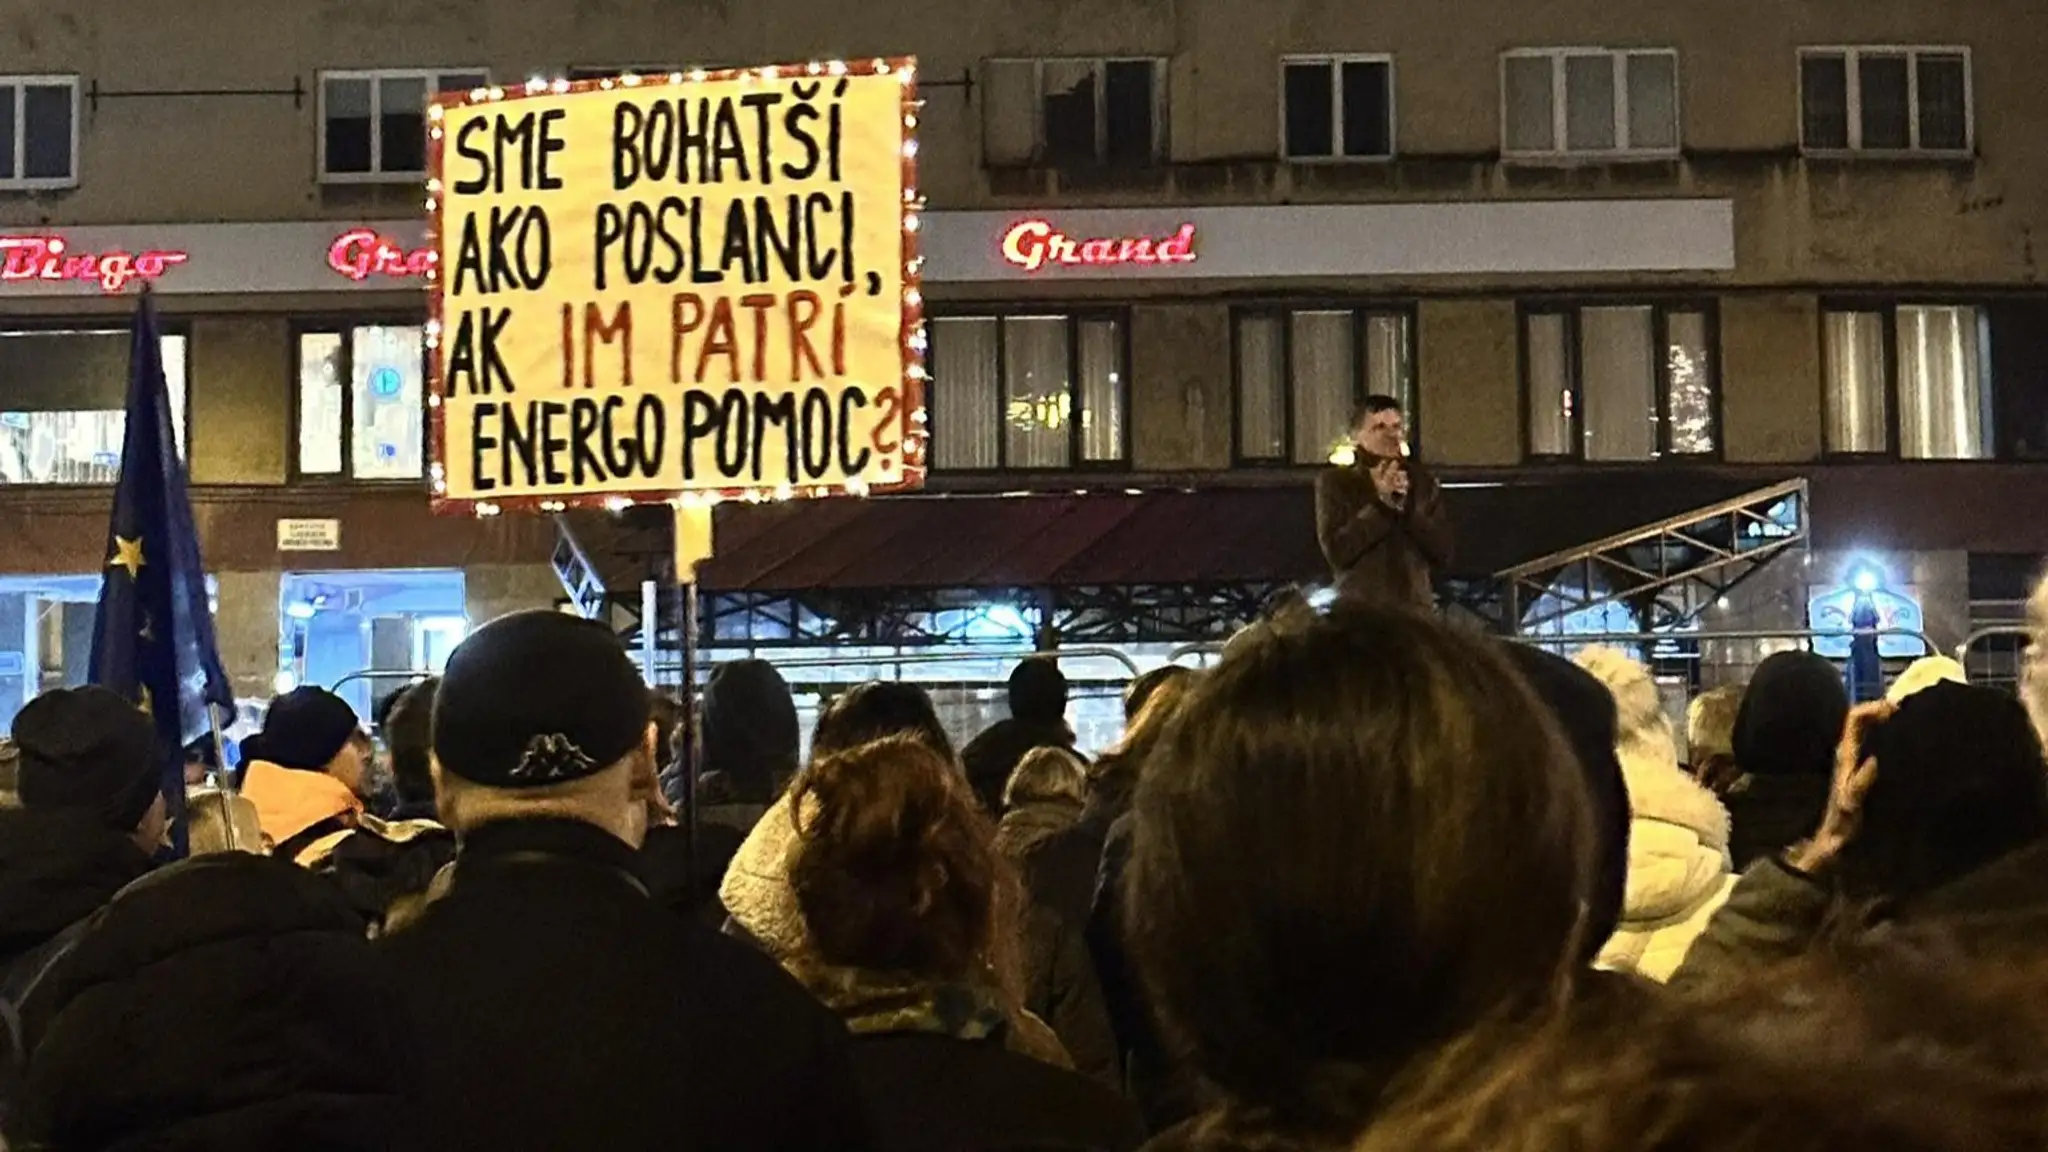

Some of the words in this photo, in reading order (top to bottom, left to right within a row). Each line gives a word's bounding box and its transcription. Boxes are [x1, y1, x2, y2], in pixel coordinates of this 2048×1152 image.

[453, 108, 566, 195] SME
[613, 78, 850, 190] BOHATŠÍ
[0, 238, 187, 291] Bingo
[452, 205, 551, 296] AKO
[594, 191, 882, 296] POSLANCI,
[1001, 219, 1197, 270] Grand
[445, 308, 516, 398] AK
[561, 300, 633, 389] IM
[670, 283, 857, 385] PATRÍ
[472, 393, 666, 491] ENERGO
[683, 386, 900, 481] POMOC?
